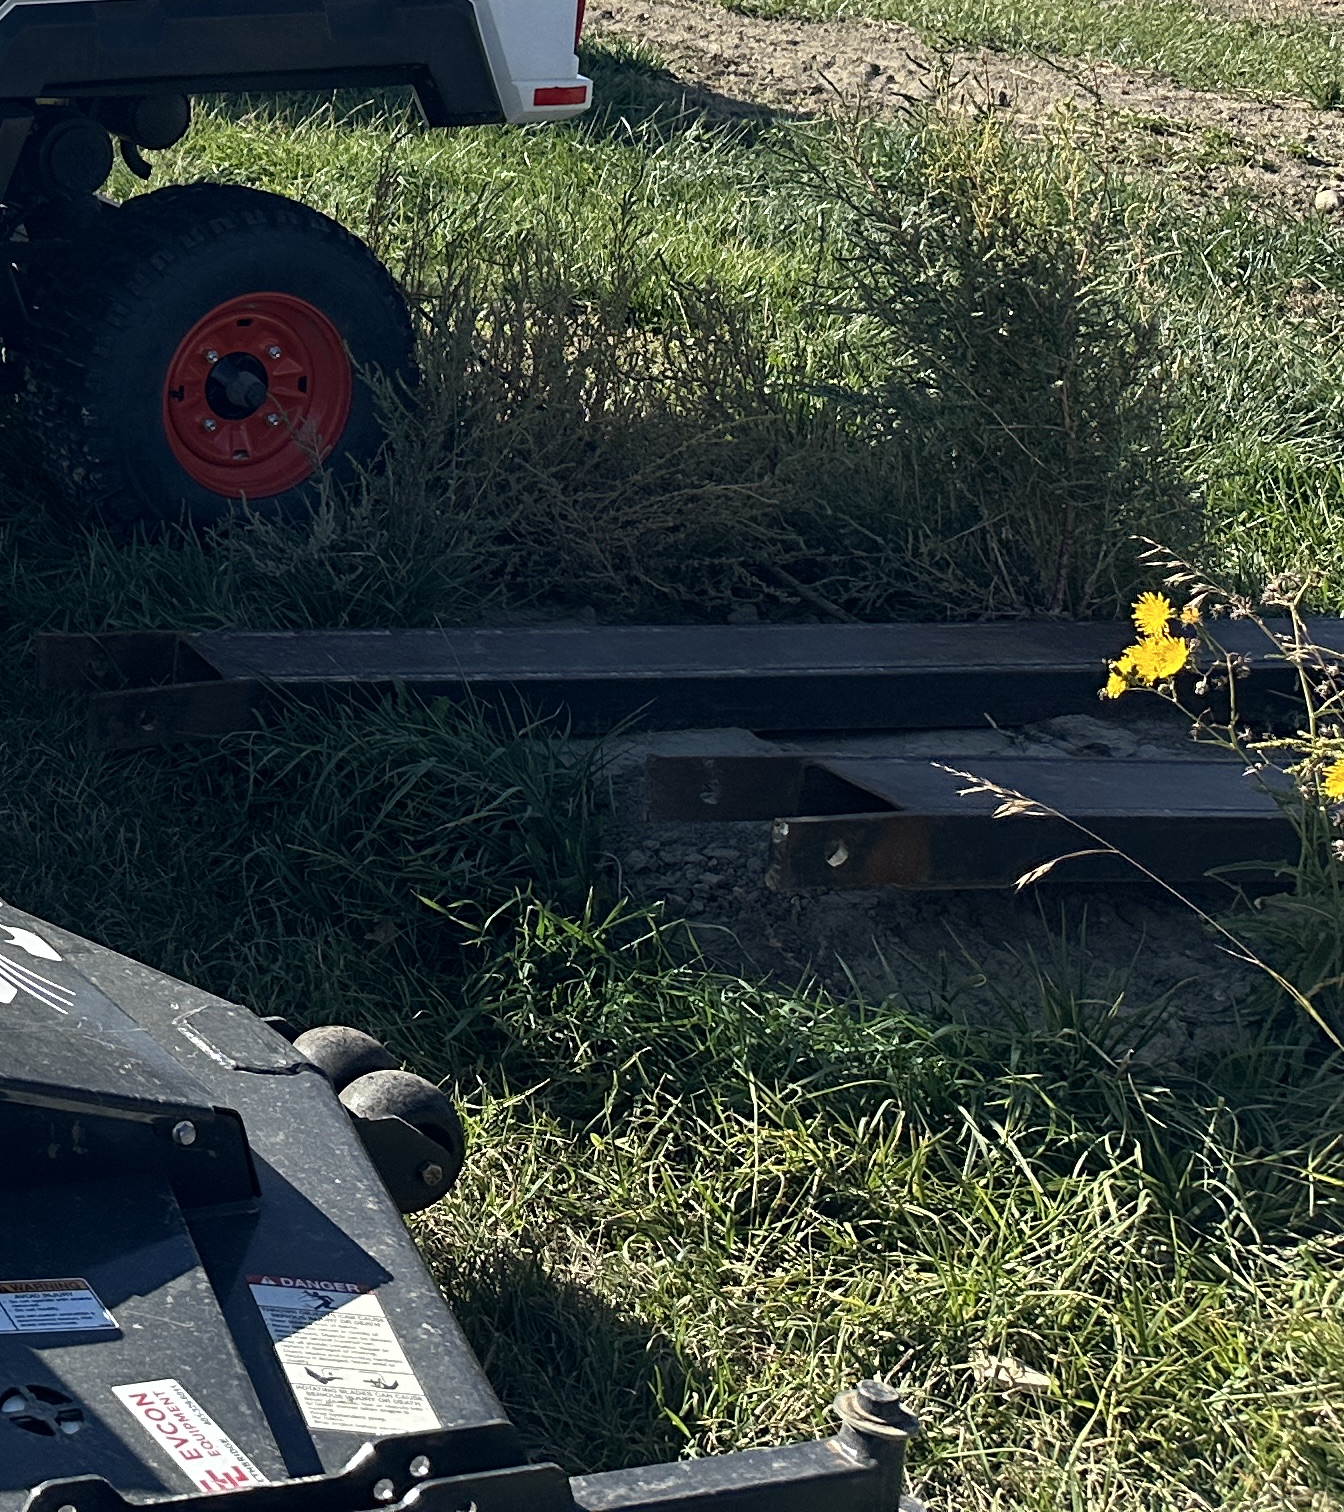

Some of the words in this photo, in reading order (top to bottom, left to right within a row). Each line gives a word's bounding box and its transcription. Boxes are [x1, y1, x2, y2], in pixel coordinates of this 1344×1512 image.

[9, 1281, 81, 1293] WARNING
[280, 1277, 361, 1293] DANGER
[128, 1392, 204, 1461] EVCON
[152, 1390, 222, 1458] EQUIPMENT
[219, 1437, 265, 1484] ETHBRIDGE
